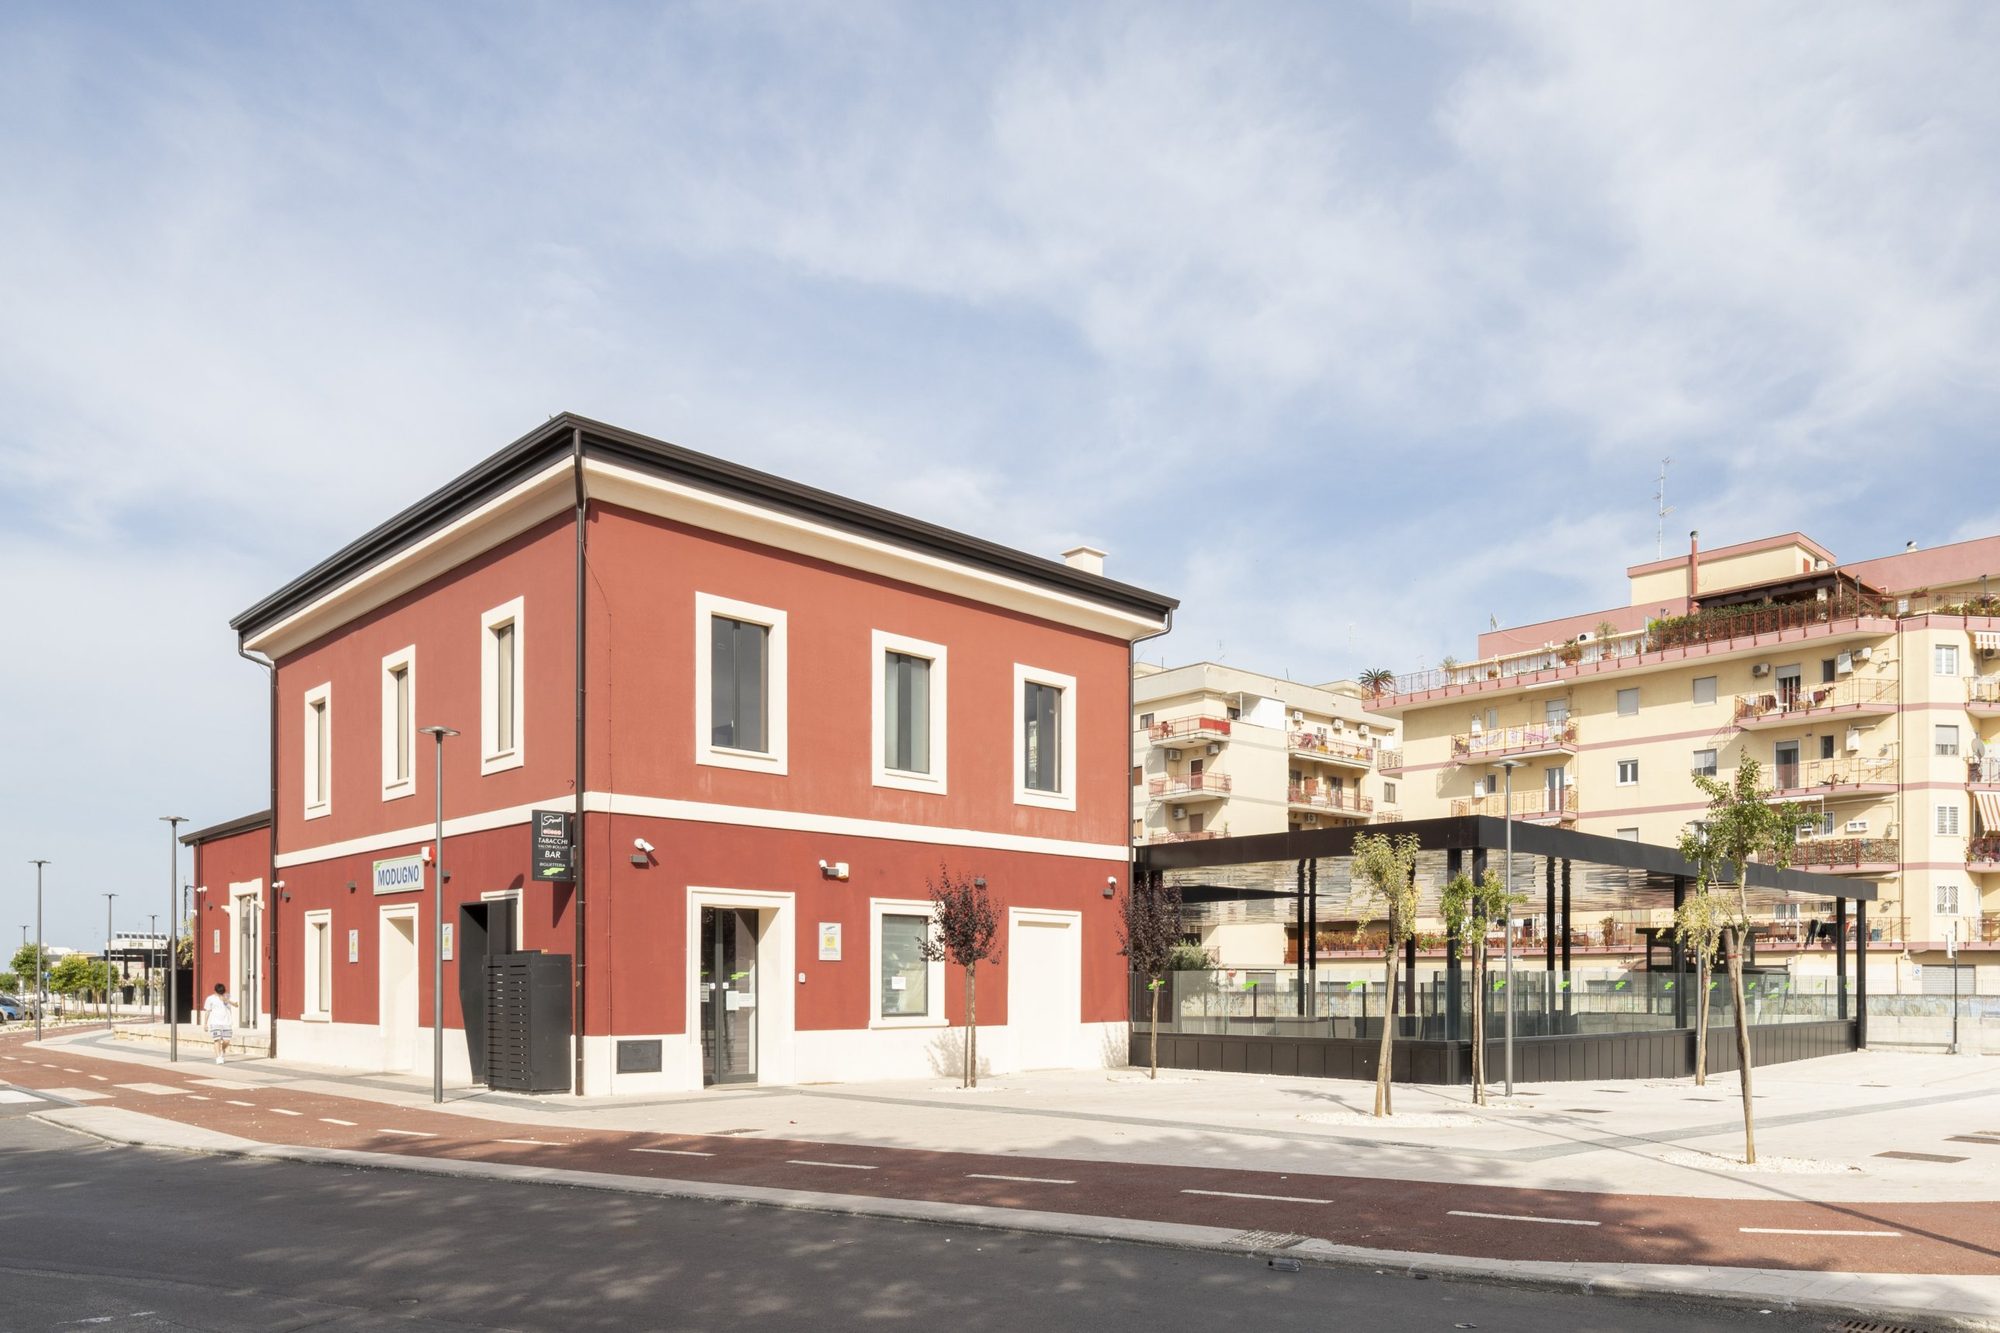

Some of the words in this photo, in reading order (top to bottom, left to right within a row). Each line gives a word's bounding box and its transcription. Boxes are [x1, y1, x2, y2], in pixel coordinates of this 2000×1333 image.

[538, 837, 569, 845] TABACCHI
[544, 850, 561, 858] BAR
[378, 864, 420, 887] MODUGNO
